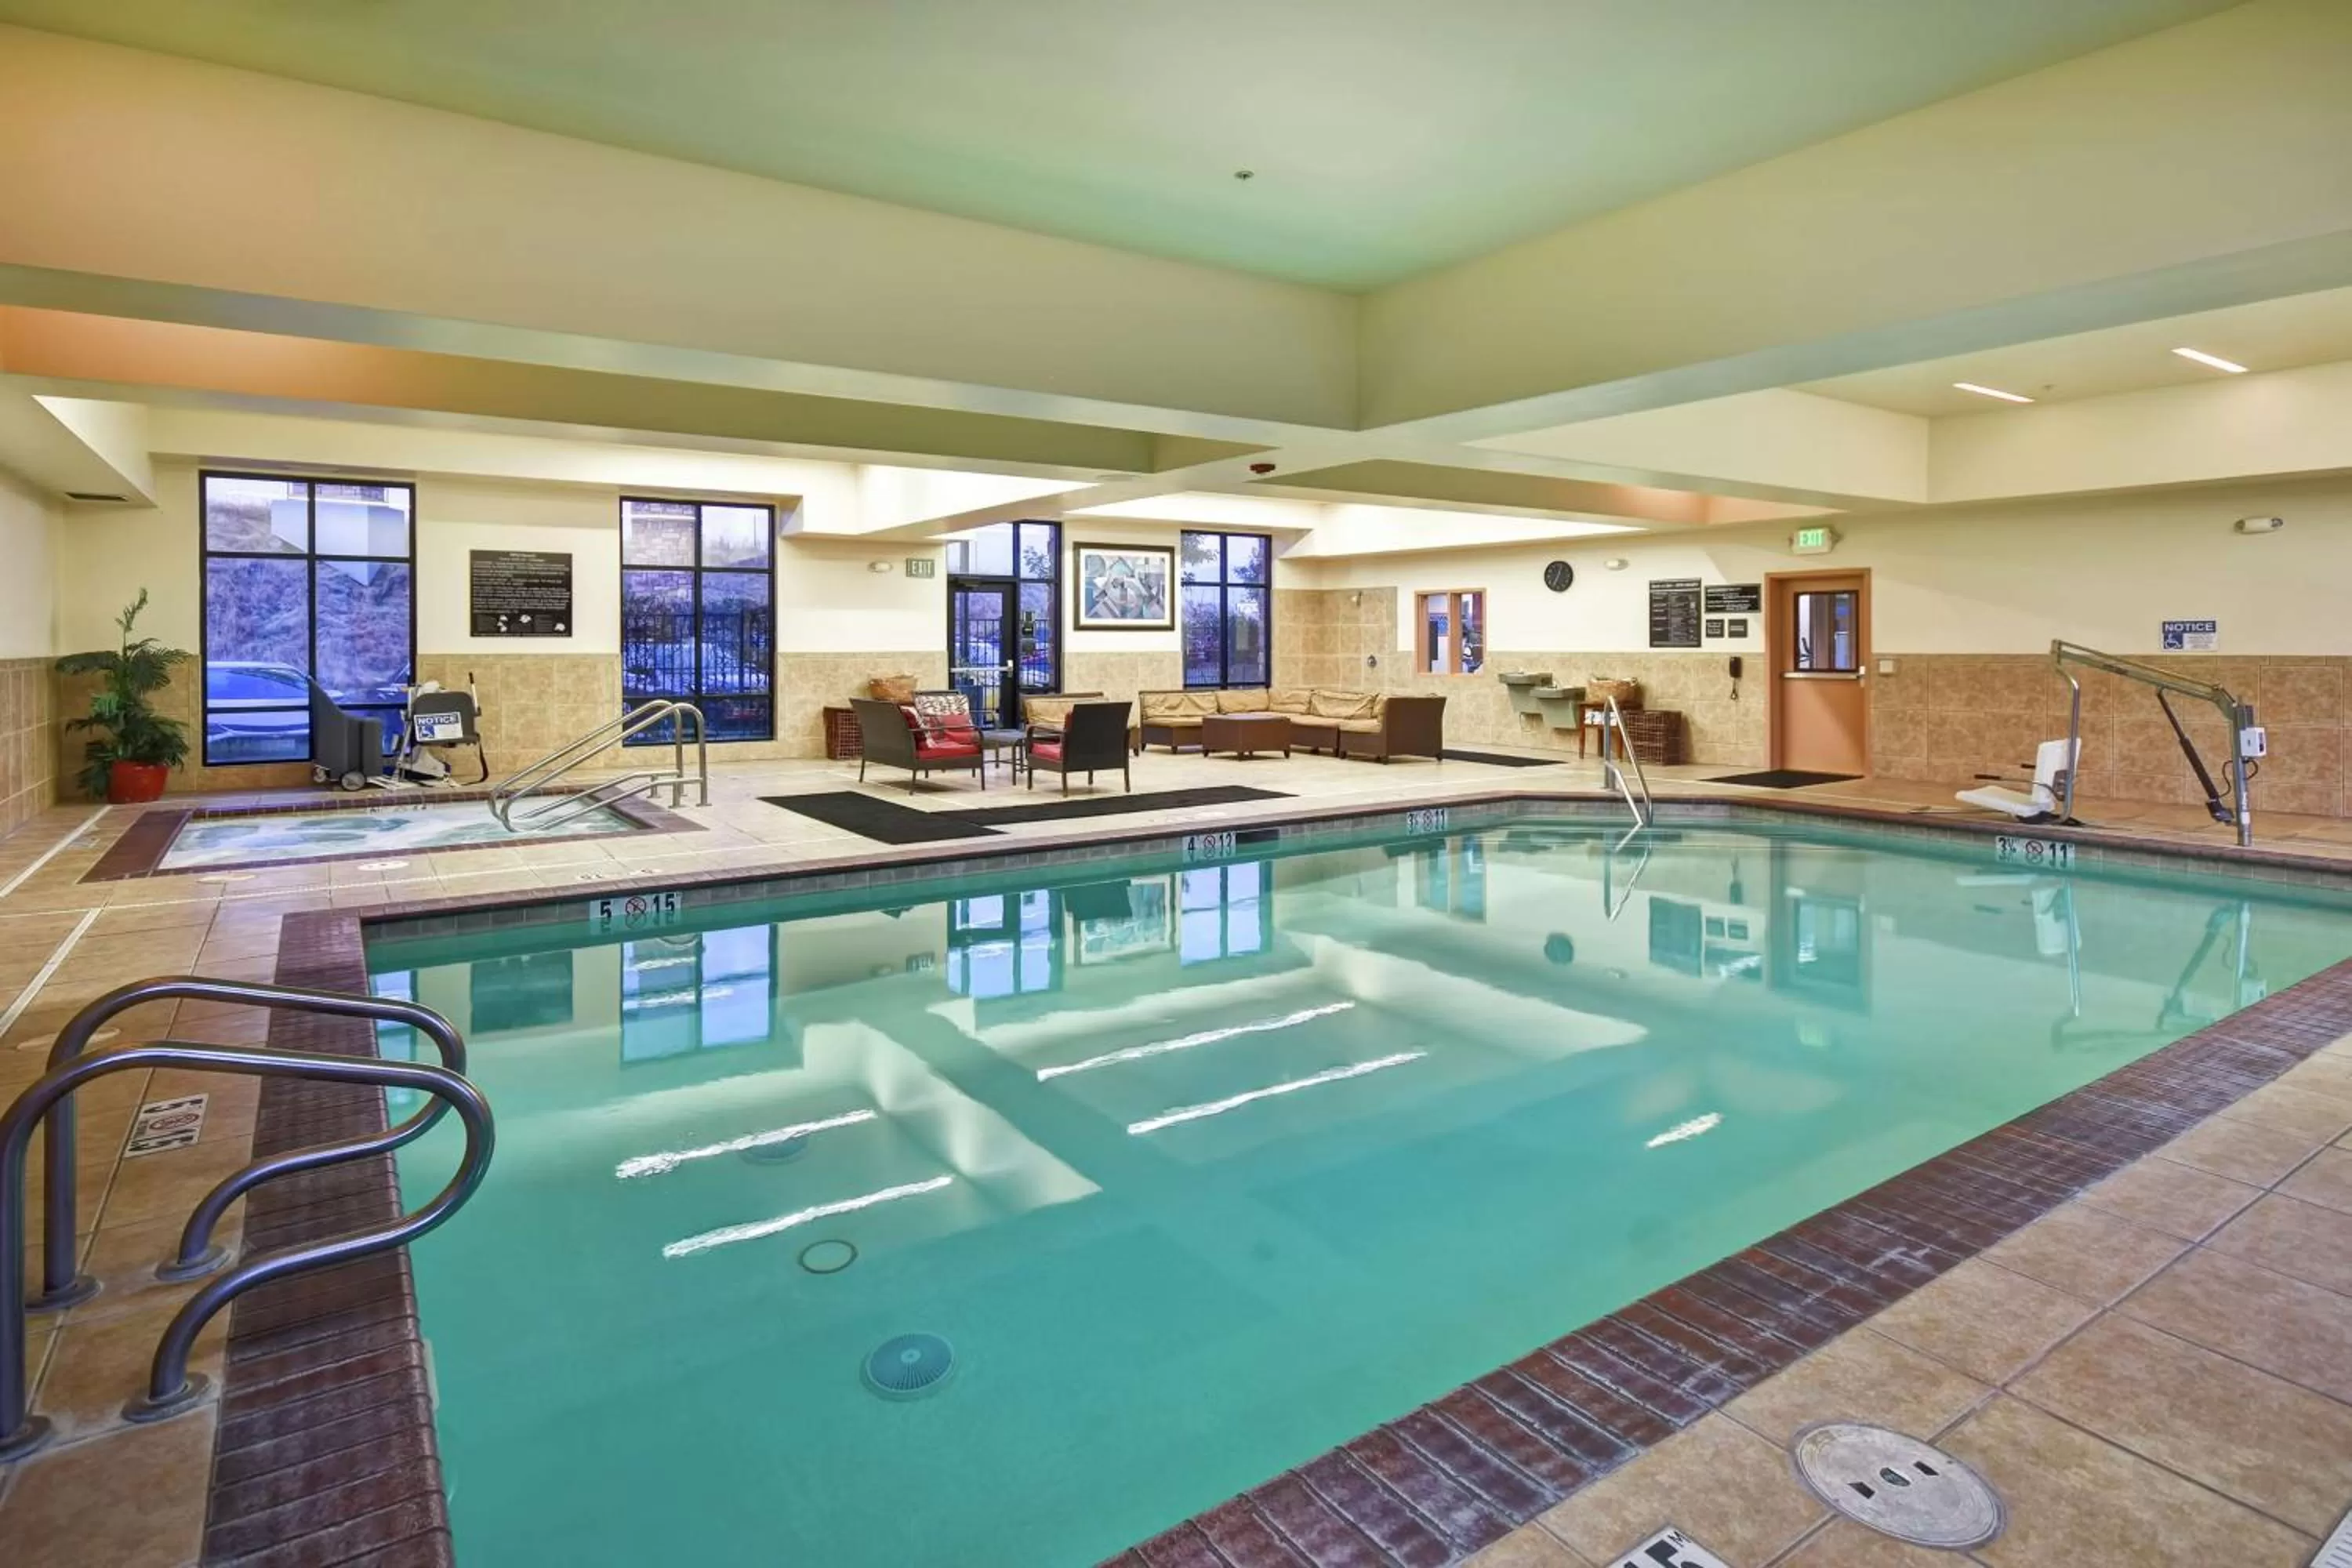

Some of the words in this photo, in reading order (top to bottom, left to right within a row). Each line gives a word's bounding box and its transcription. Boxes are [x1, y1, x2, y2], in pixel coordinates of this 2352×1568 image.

[2165, 622, 2214, 631] NOTICE
[1187, 837, 1196, 851] 4
[600, 900, 612, 918] 5
